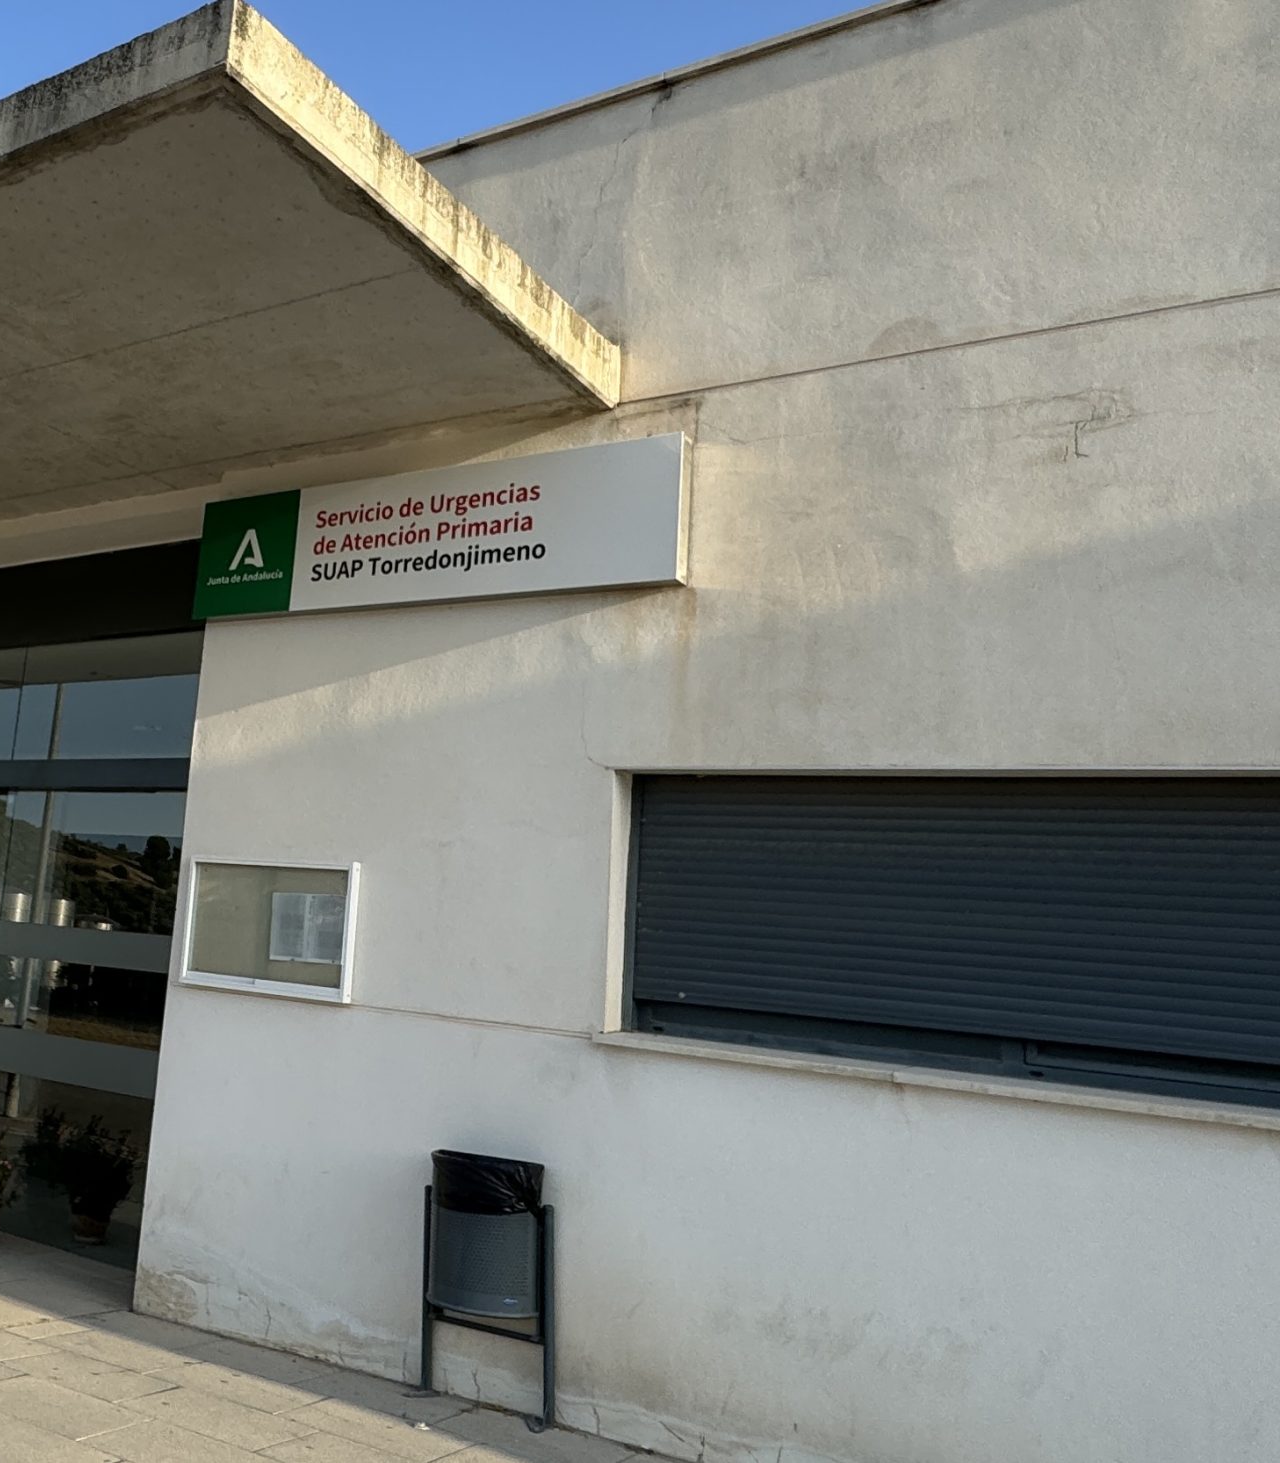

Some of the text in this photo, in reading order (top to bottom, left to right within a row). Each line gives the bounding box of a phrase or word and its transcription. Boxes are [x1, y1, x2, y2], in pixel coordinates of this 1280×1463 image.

[315, 482, 541, 529] Servicio de Urgencias
[312, 510, 534, 556] de Atención Primaria
[206, 568, 284, 586] Junta de Andalucía
[310, 542, 547, 583] SUAP Torredonjimeno
